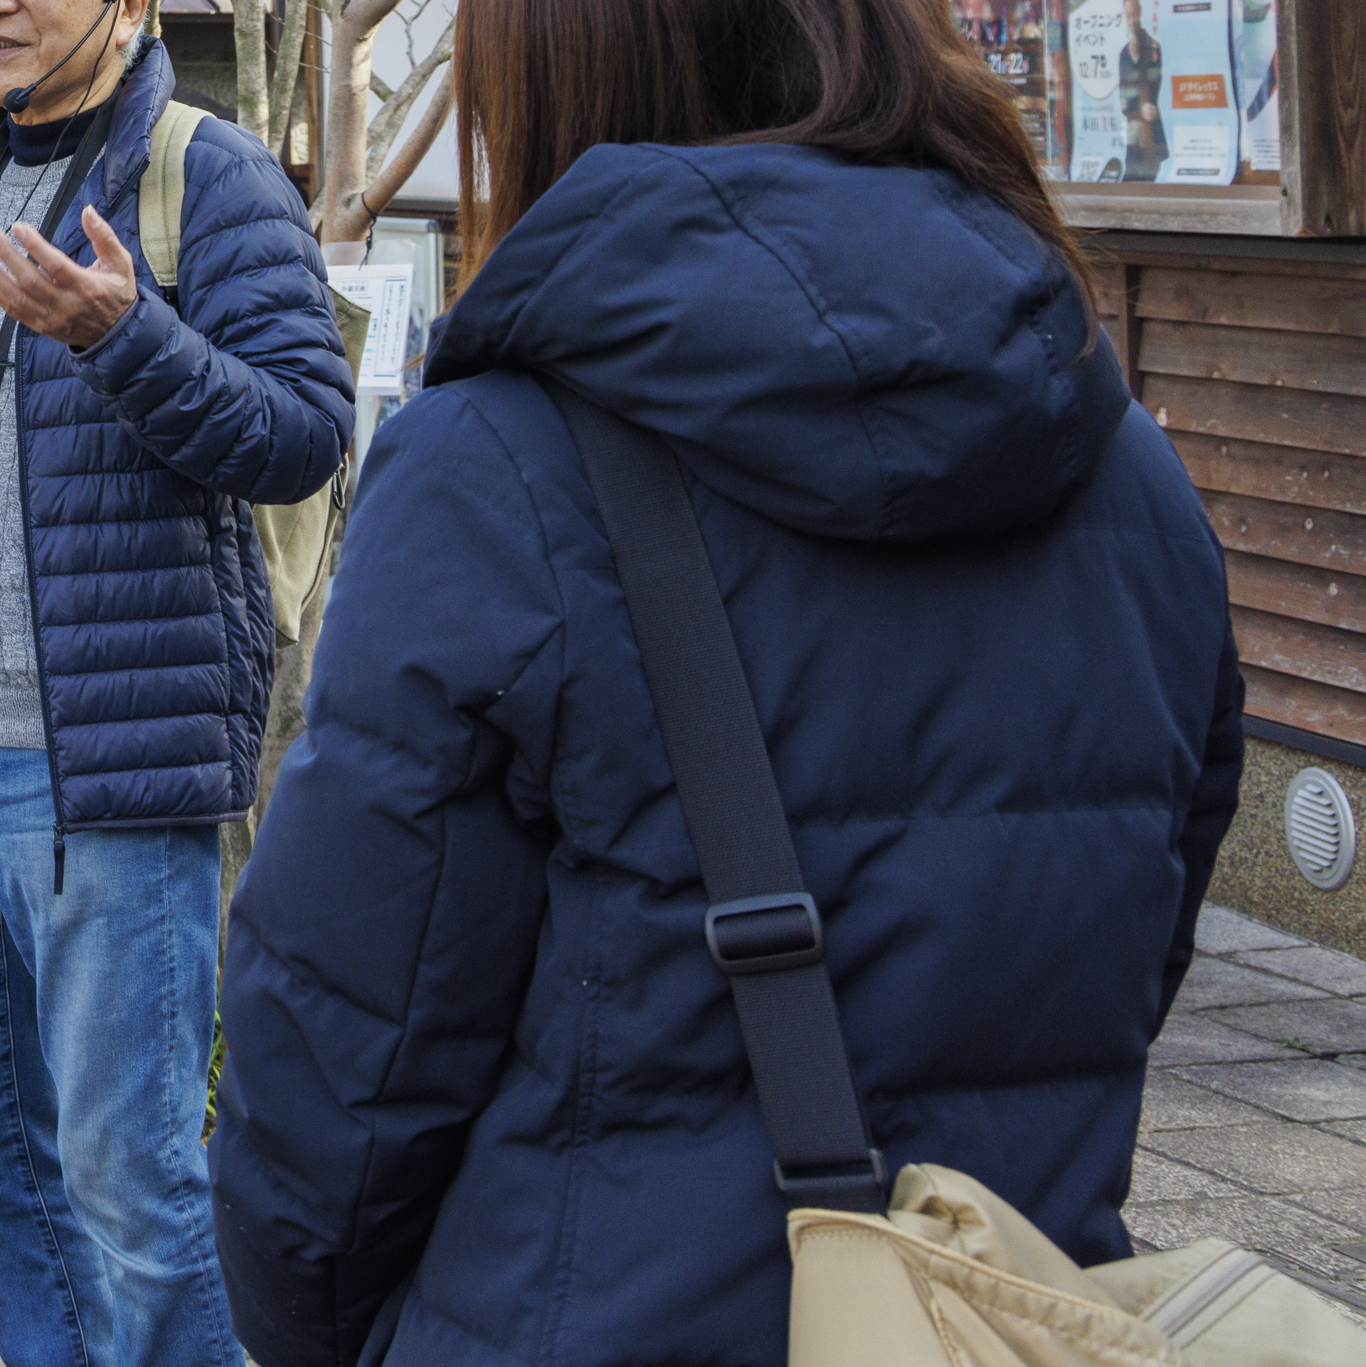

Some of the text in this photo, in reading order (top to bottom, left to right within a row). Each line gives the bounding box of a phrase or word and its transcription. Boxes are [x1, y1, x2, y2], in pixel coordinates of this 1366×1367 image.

[1075, 12, 1123, 29] オープニング
[1075, 33, 1106, 47] イベント
